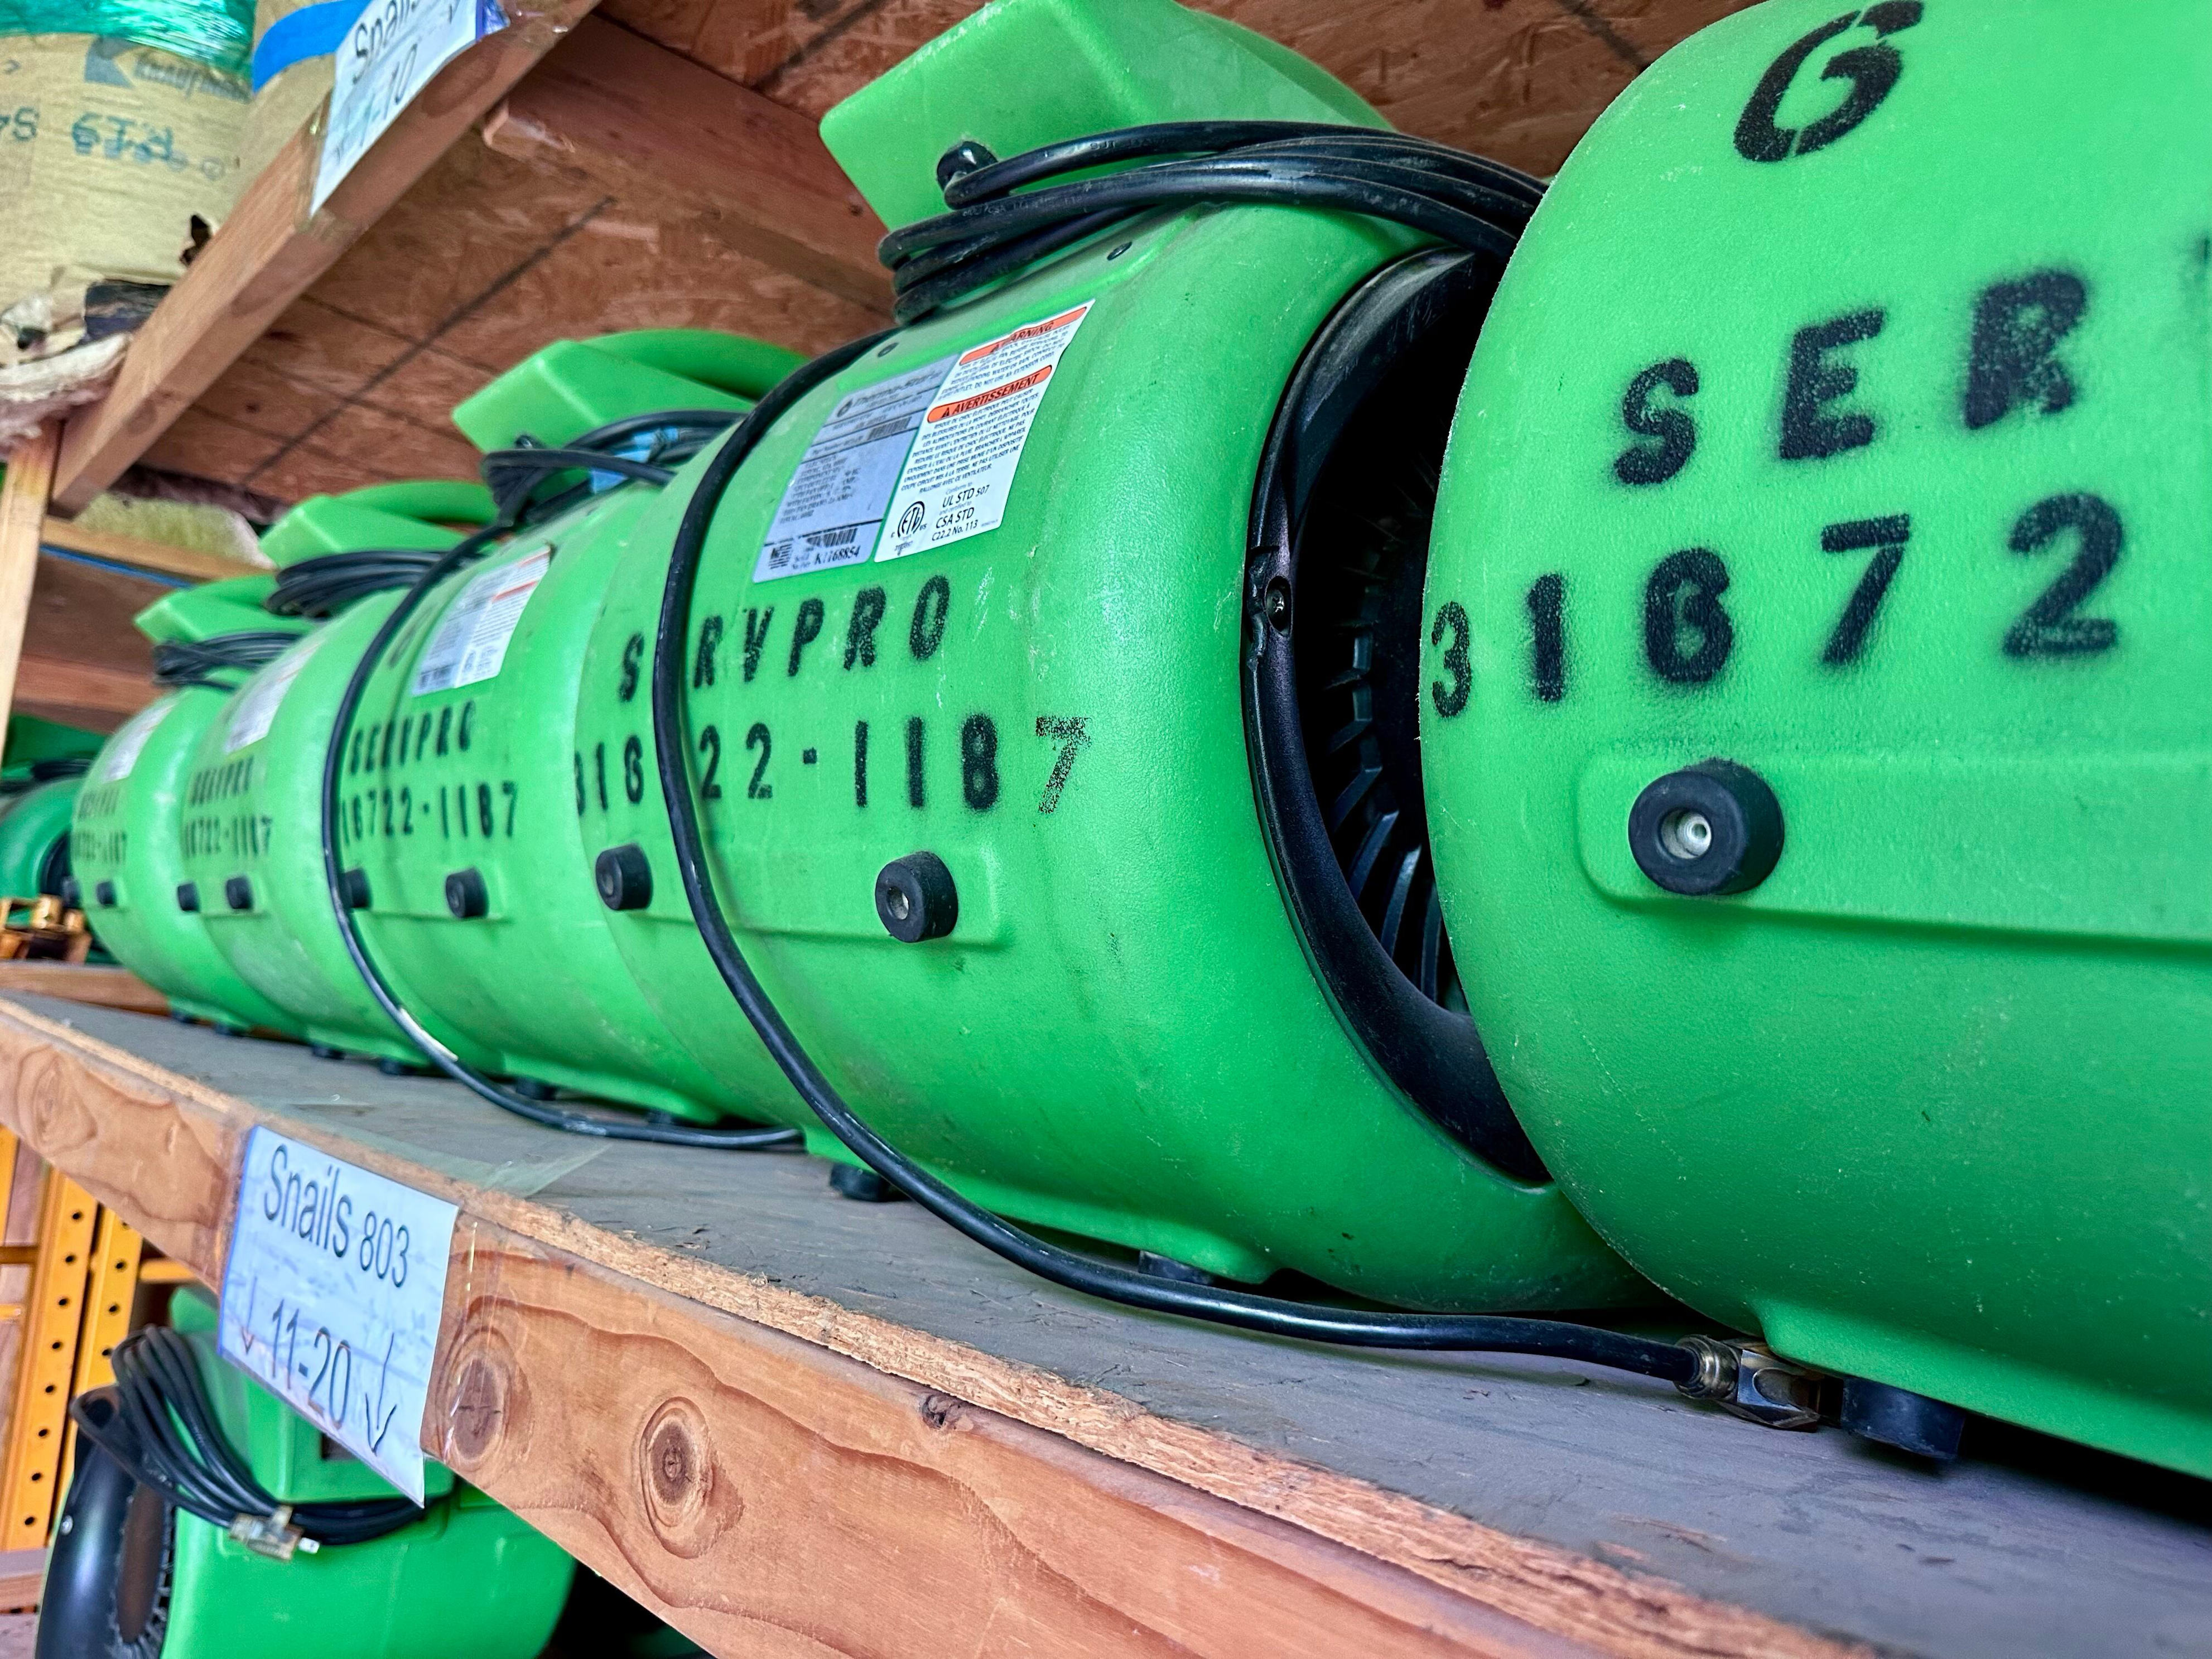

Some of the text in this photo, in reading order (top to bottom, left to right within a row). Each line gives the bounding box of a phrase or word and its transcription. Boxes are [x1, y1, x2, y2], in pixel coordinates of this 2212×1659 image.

[353, 0, 417, 84] Snail
[953, 373, 1040, 414] AVERTISSEMENT
[1607, 232, 2212, 487] SER
[932, 530, 952, 541] C22.2
[966, 519, 978, 531] 113
[936, 507, 975, 529] CSA STD
[942, 496, 953, 508] UL
[956, 488, 975, 504] STD
[618, 575, 950, 702] SRVPRO
[264, 1144, 410, 1289] Snails 803
[271, 1299, 351, 1430] 11-20
